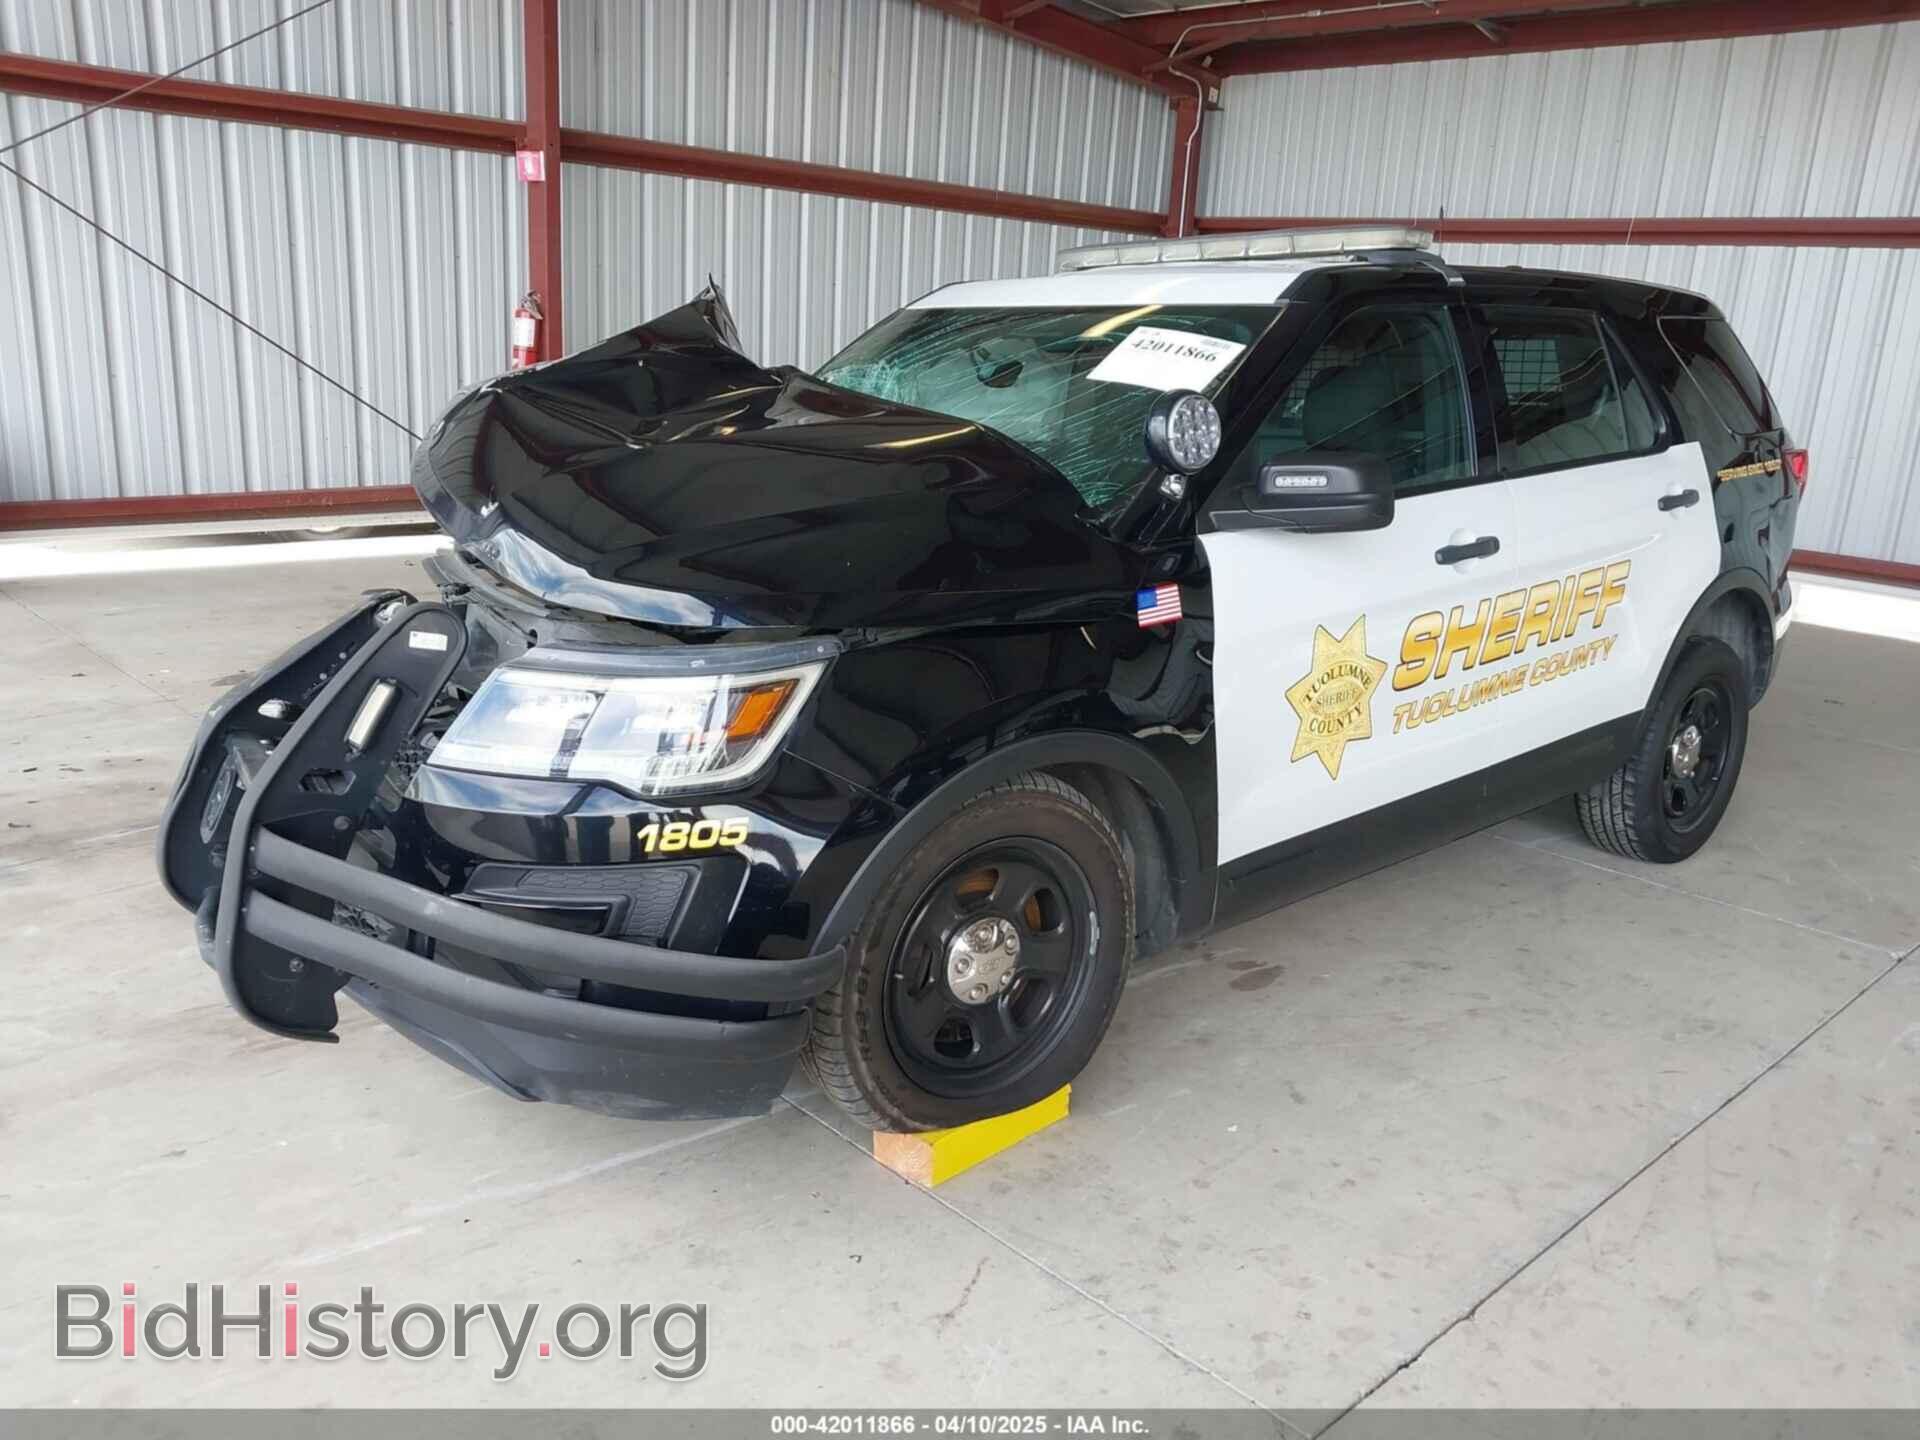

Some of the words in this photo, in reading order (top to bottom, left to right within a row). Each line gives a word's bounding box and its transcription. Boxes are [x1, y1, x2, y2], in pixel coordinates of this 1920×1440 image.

[1131, 338, 1217, 362] 42011866
[1391, 559, 1632, 691] SHERIFF
[1303, 663, 1374, 702] TUOLUMNE
[1315, 686, 1362, 707] SHERIFF
[1392, 663, 1530, 734] TUOLUMNE
[1529, 634, 1619, 685] COUNTY
[1308, 702, 1363, 733] COUNTY
[637, 816, 749, 853] 1805
